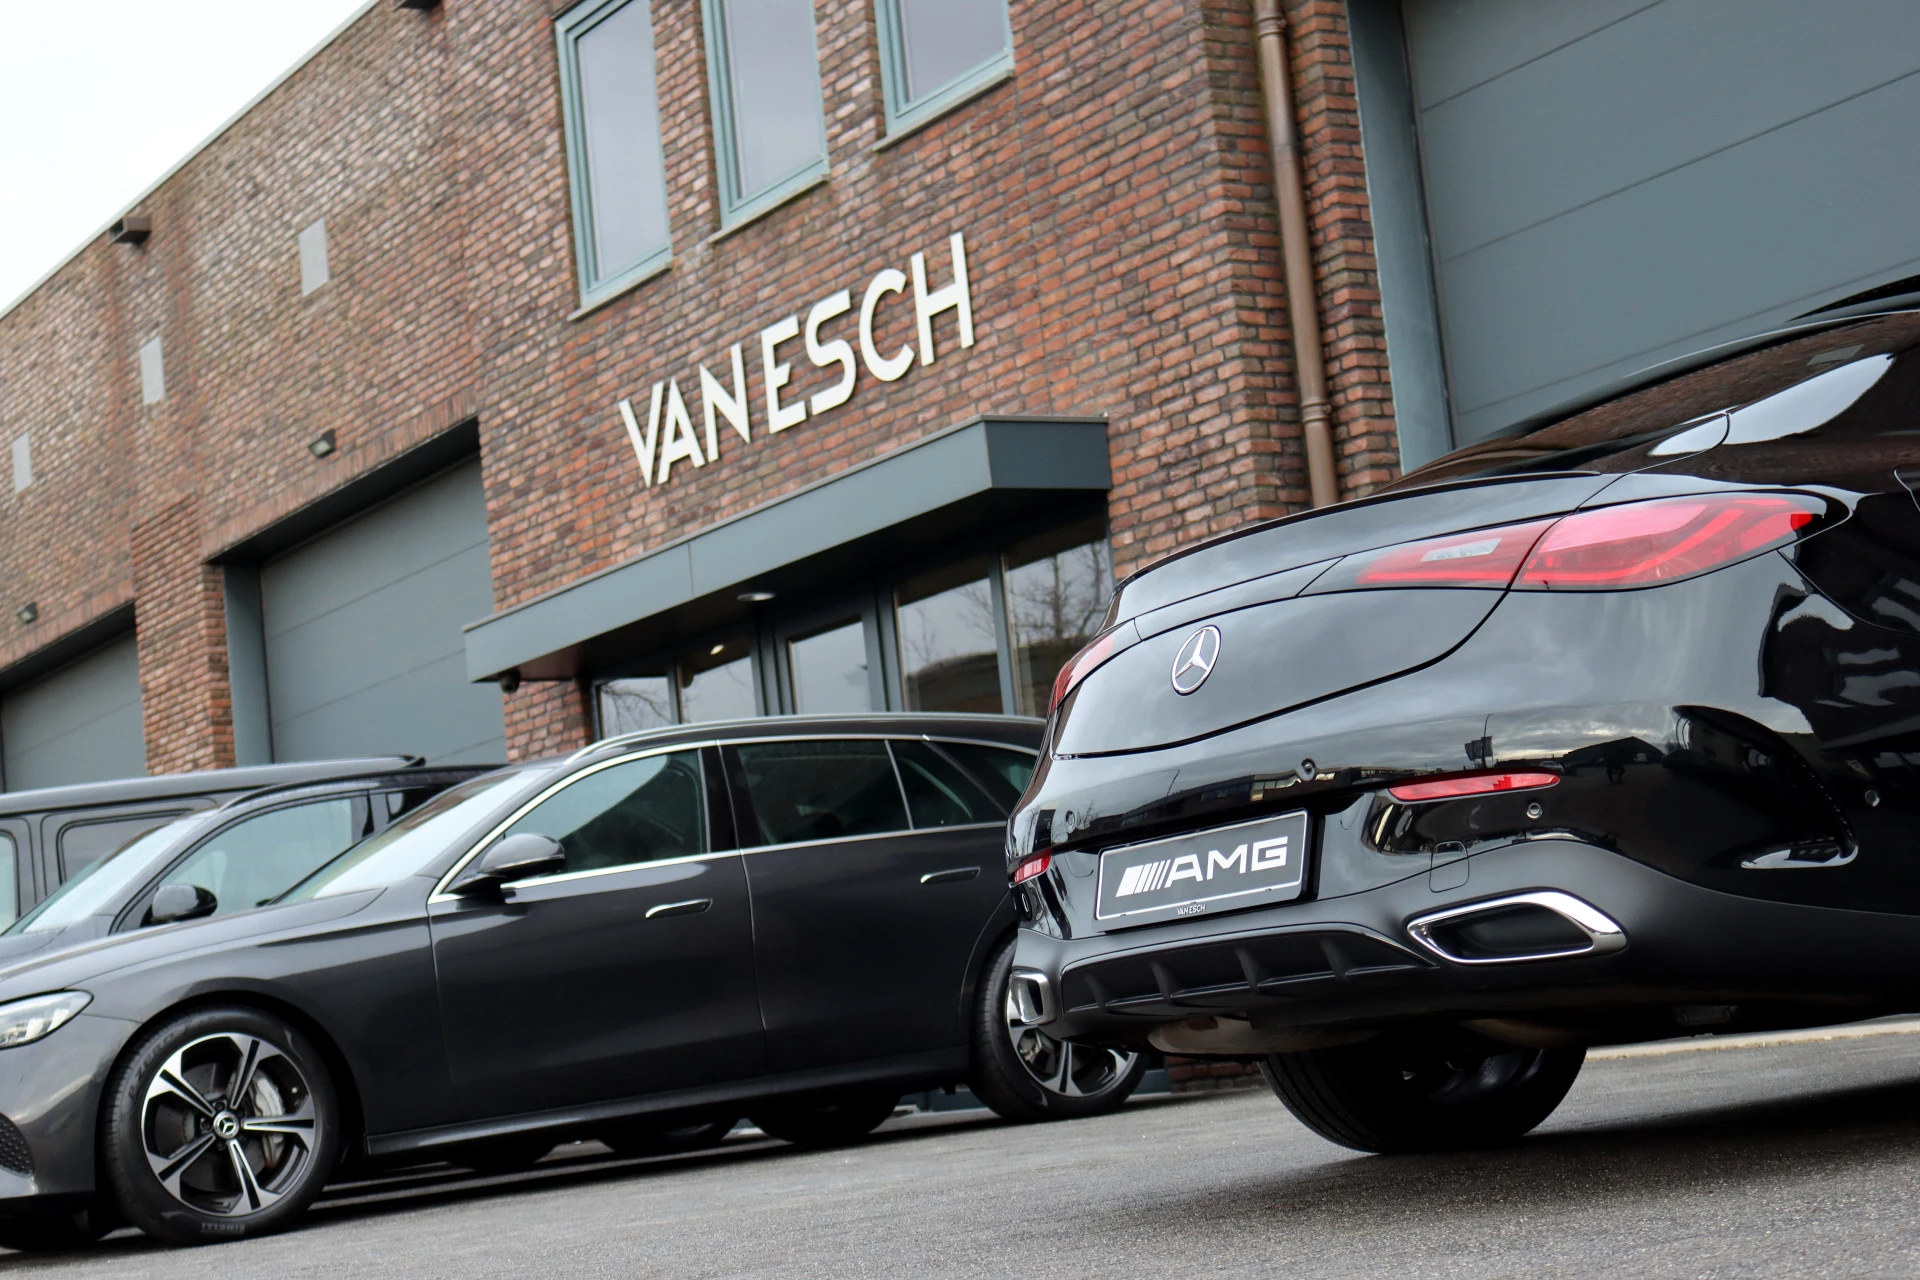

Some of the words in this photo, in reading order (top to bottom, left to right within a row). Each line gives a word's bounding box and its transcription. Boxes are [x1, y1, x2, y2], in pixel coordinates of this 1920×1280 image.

[618, 342, 751, 488] VAN
[760, 232, 974, 435] ESCH
[1163, 834, 1289, 889] AMG
[1189, 903, 1206, 914] ESCH
